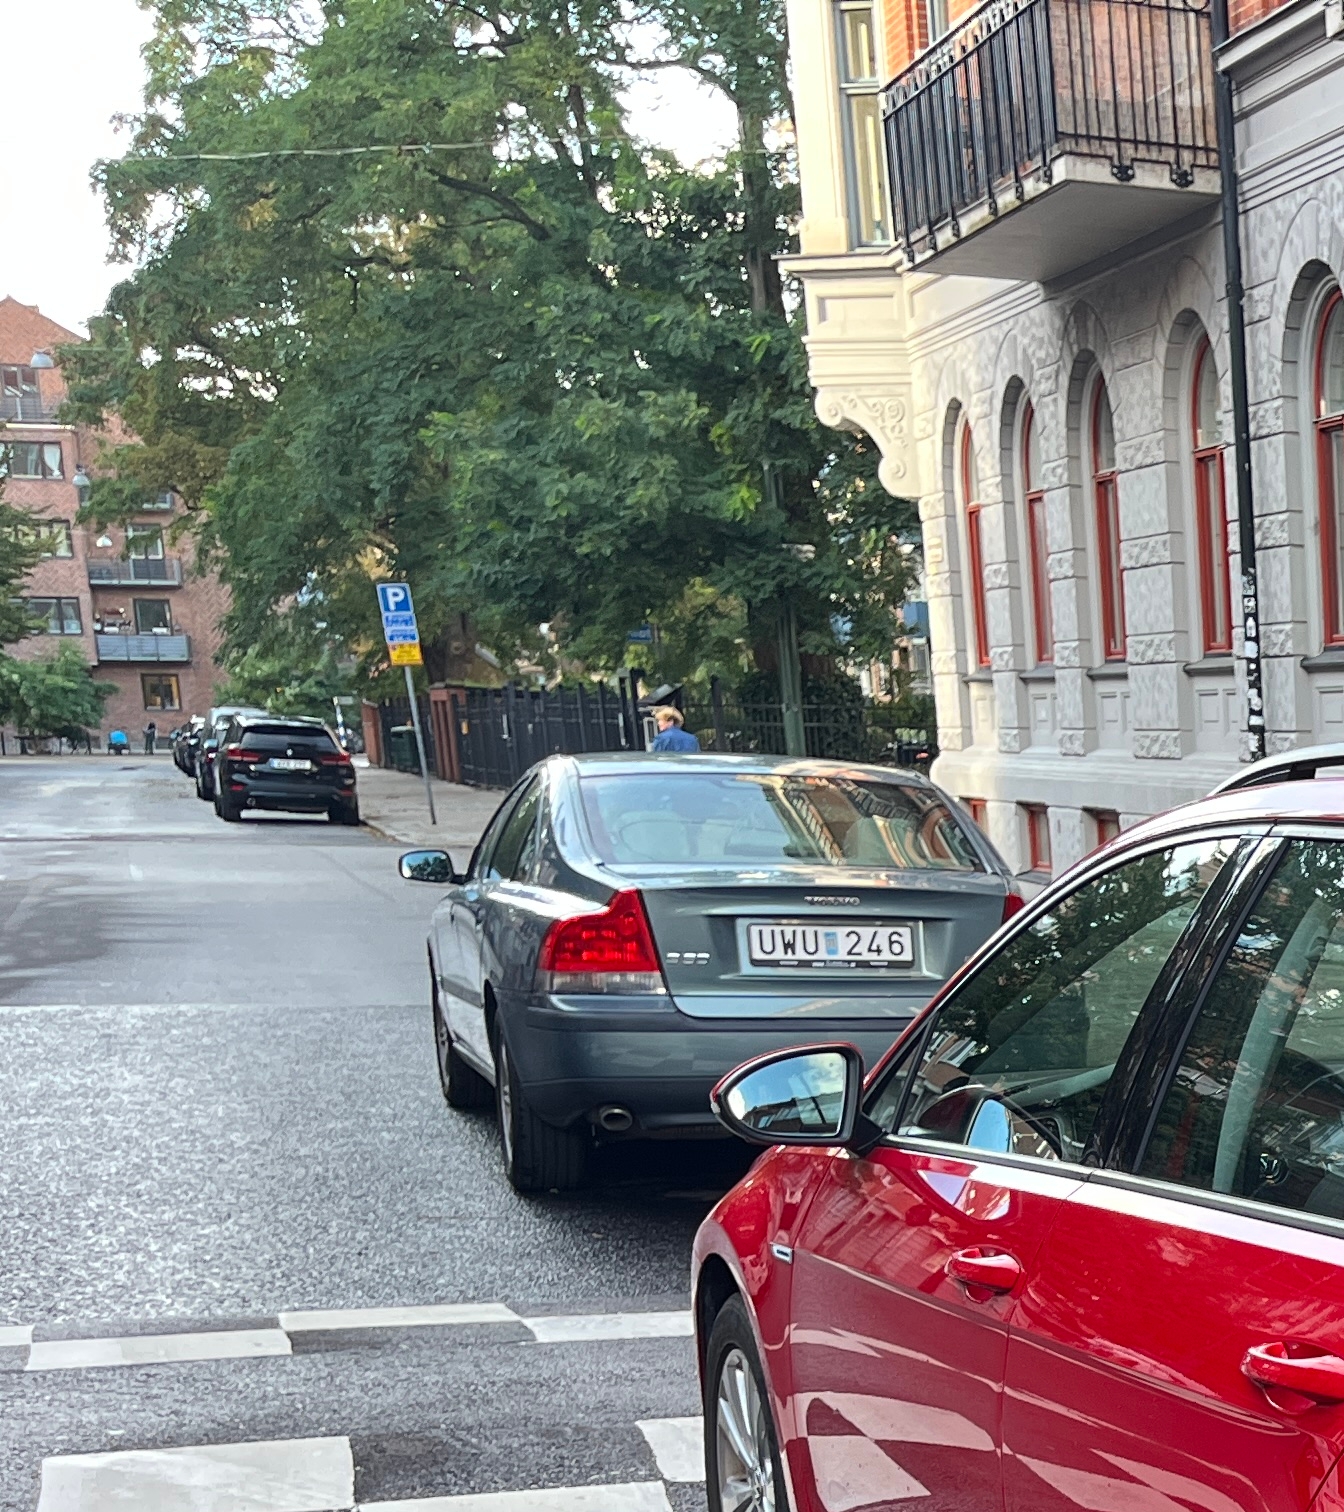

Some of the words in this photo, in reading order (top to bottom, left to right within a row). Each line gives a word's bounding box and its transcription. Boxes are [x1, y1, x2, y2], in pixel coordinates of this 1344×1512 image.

[386, 587, 405, 611] P
[758, 929, 819, 956] UWU
[845, 930, 904, 956] 246
